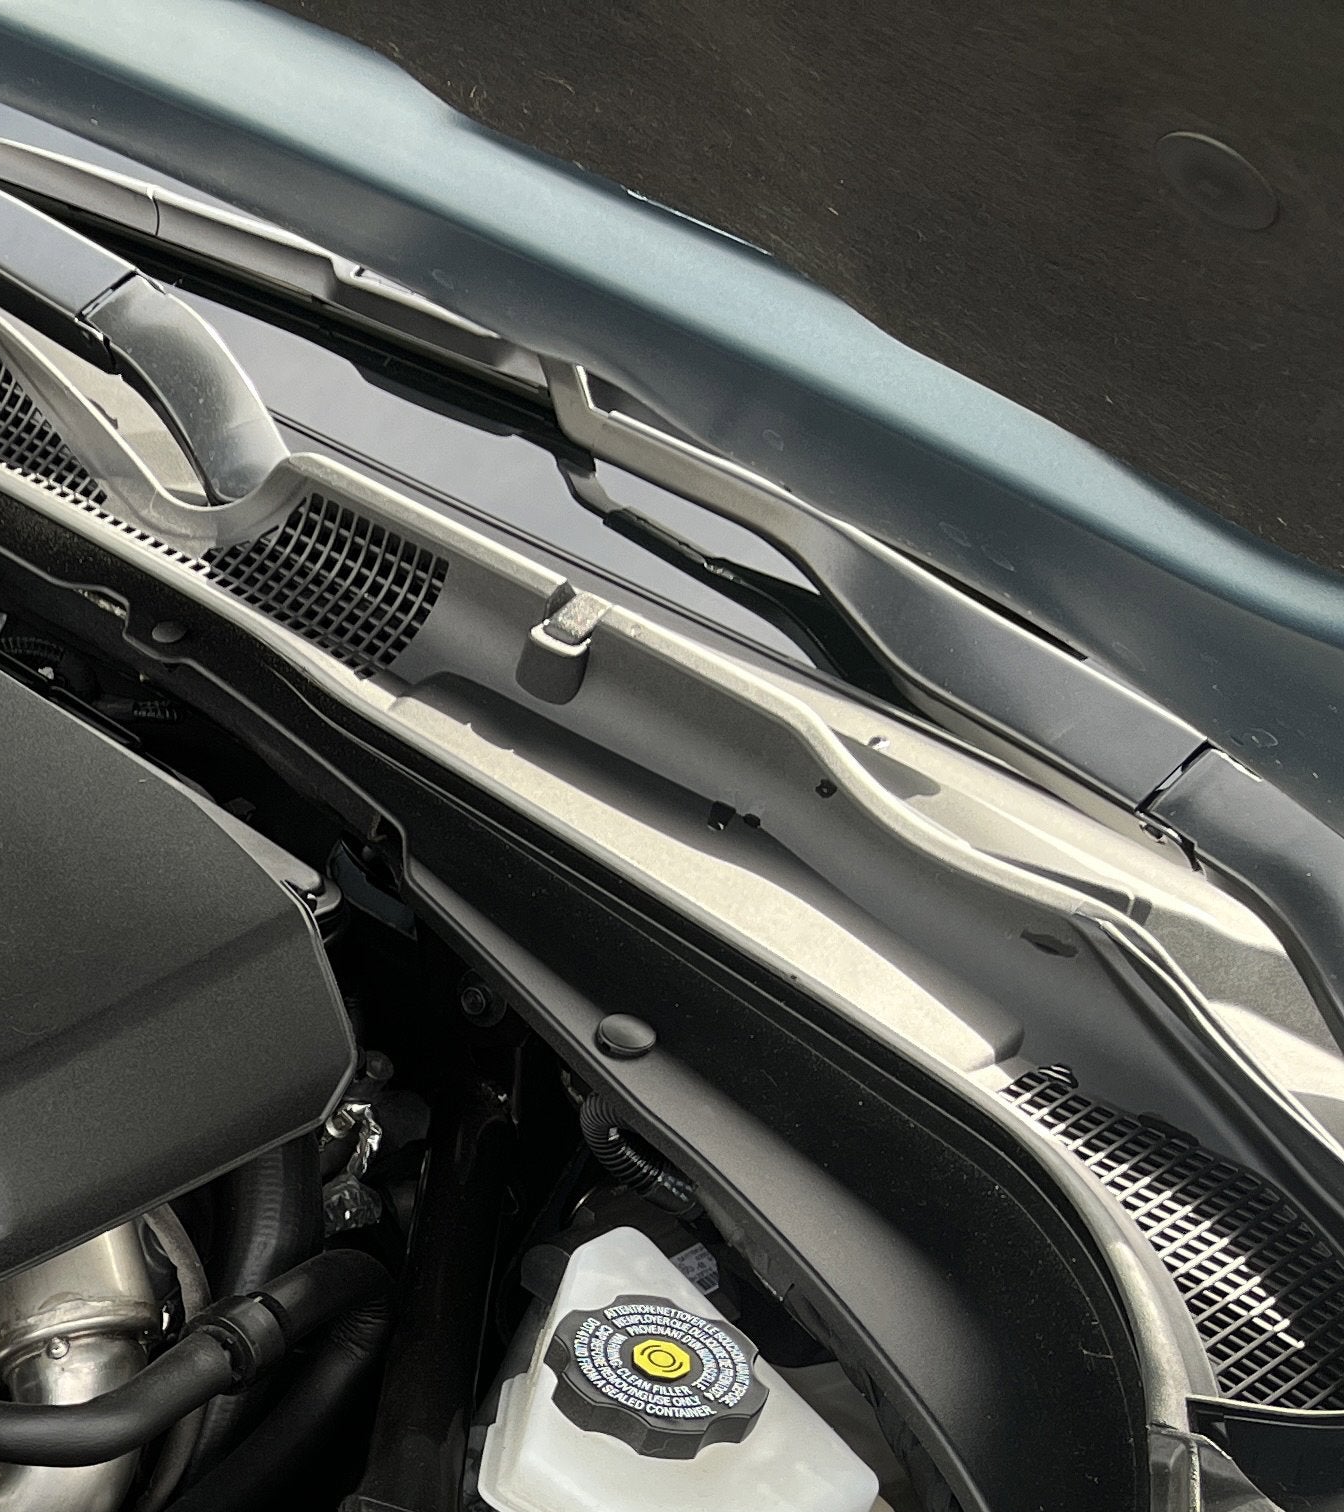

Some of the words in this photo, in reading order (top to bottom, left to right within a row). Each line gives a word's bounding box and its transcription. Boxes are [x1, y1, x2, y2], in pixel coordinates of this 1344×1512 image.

[613, 1367, 652, 1392] CLEAN
[650, 1384, 694, 1396] FILLER
[598, 1384, 645, 1412] SEALED
[671, 1394, 704, 1406] ONLY
